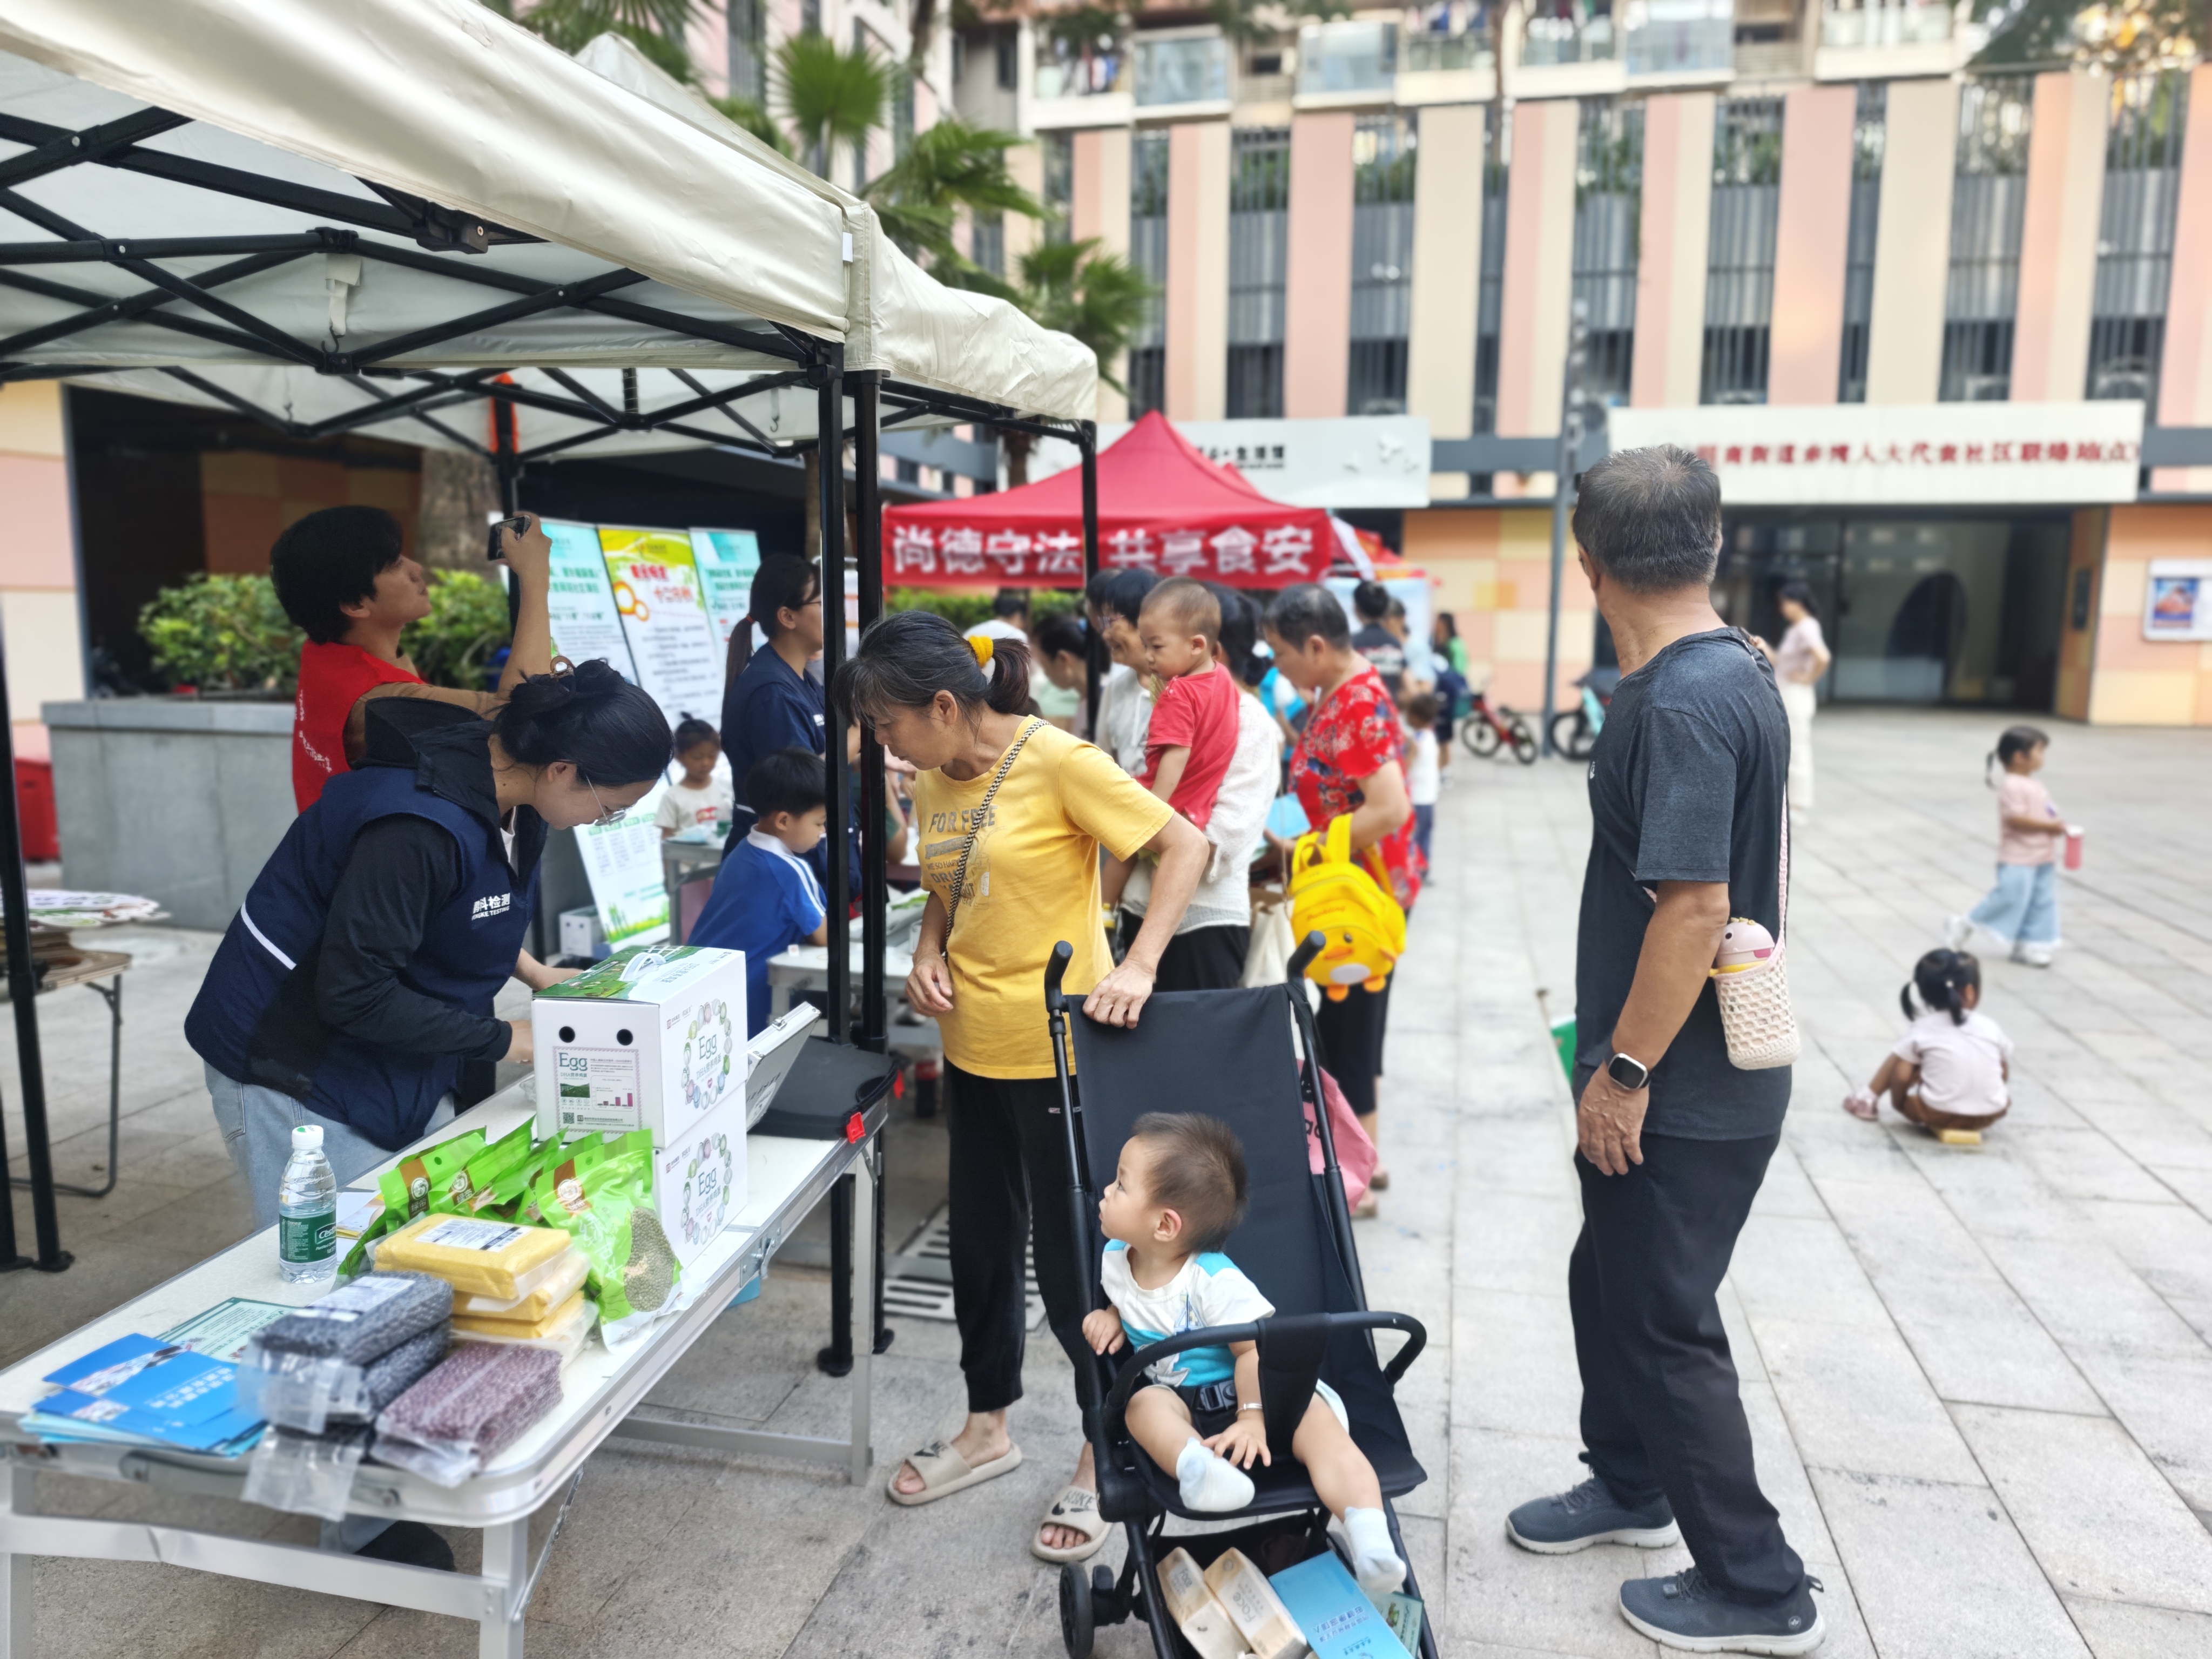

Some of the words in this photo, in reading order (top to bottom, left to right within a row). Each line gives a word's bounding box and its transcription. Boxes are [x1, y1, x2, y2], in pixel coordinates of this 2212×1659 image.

[892, 525, 1083, 575] 尚德守法
[1107, 525, 1314, 575] 共享食安
[928, 811, 957, 833] FOR
[699, 1034, 718, 1060] Egg
[558, 1053, 588, 1071] Egg
[698, 1168, 717, 1197] Egg
